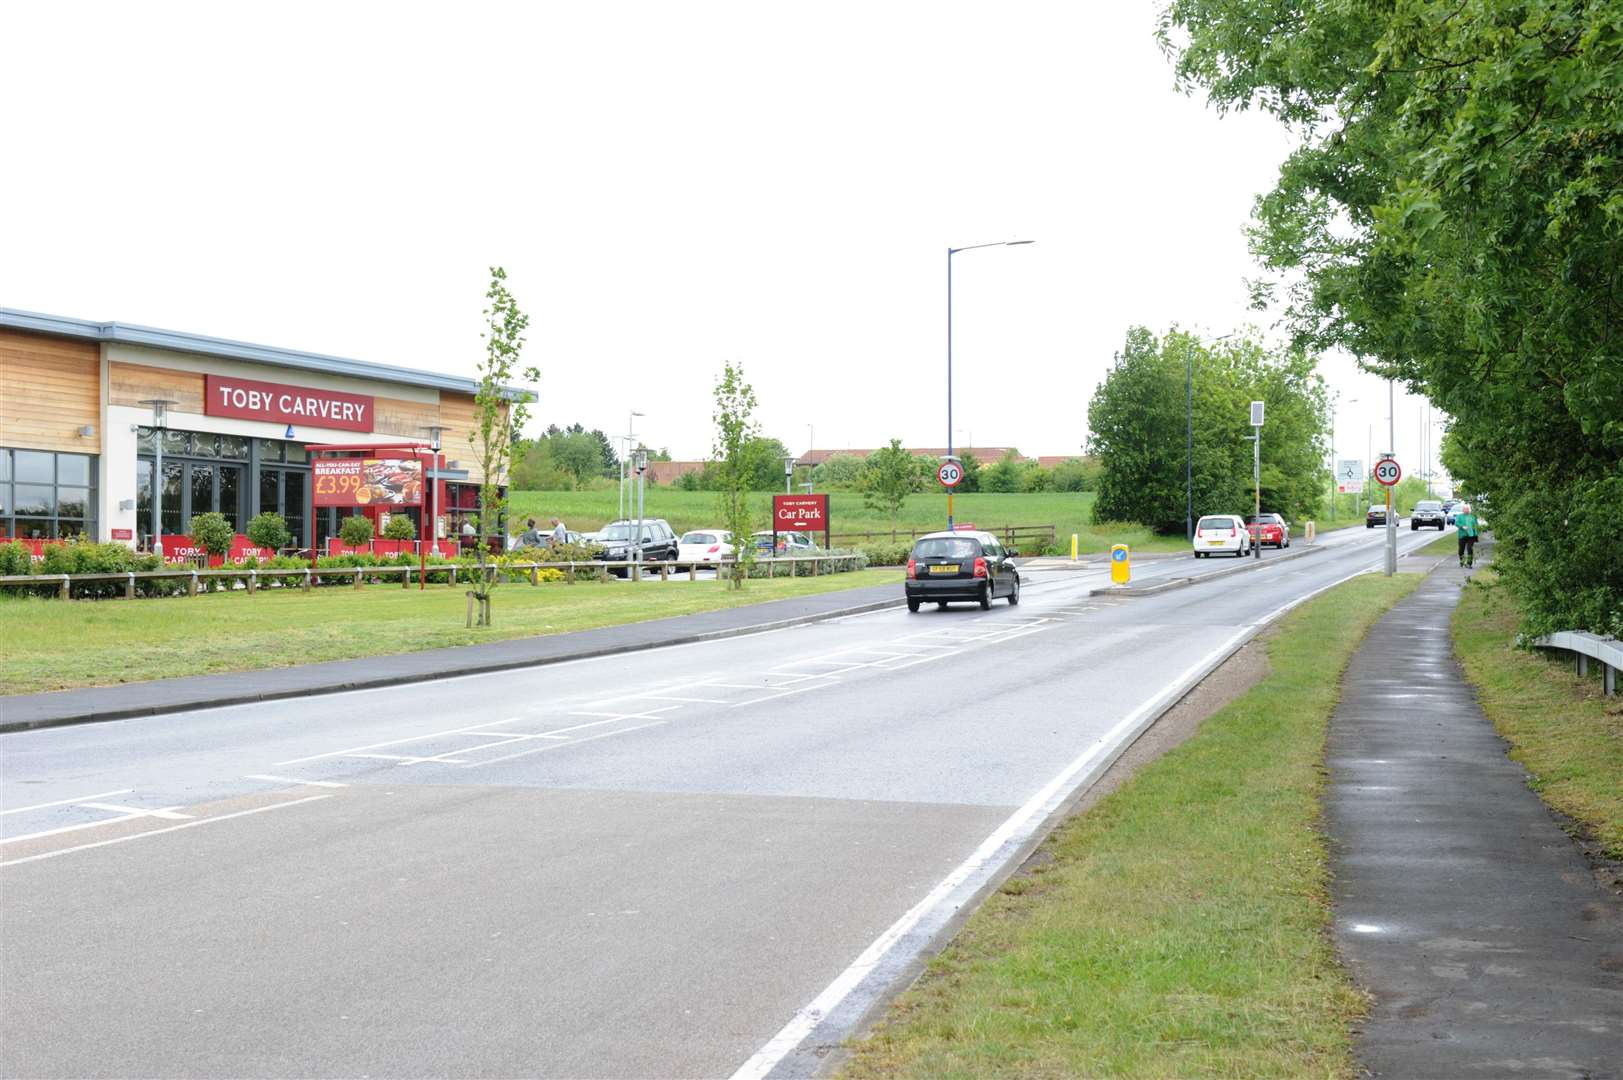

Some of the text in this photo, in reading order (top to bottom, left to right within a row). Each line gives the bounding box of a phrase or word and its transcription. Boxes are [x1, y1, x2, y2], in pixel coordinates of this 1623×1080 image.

[219, 386, 365, 422] TOBY CARVERY
[315, 467, 361, 475] BREAKFAST
[941, 469, 958, 480] 30
[1378, 466, 1398, 478] 30
[315, 475, 361, 494] £3.99
[778, 507, 821, 519] Car Park
